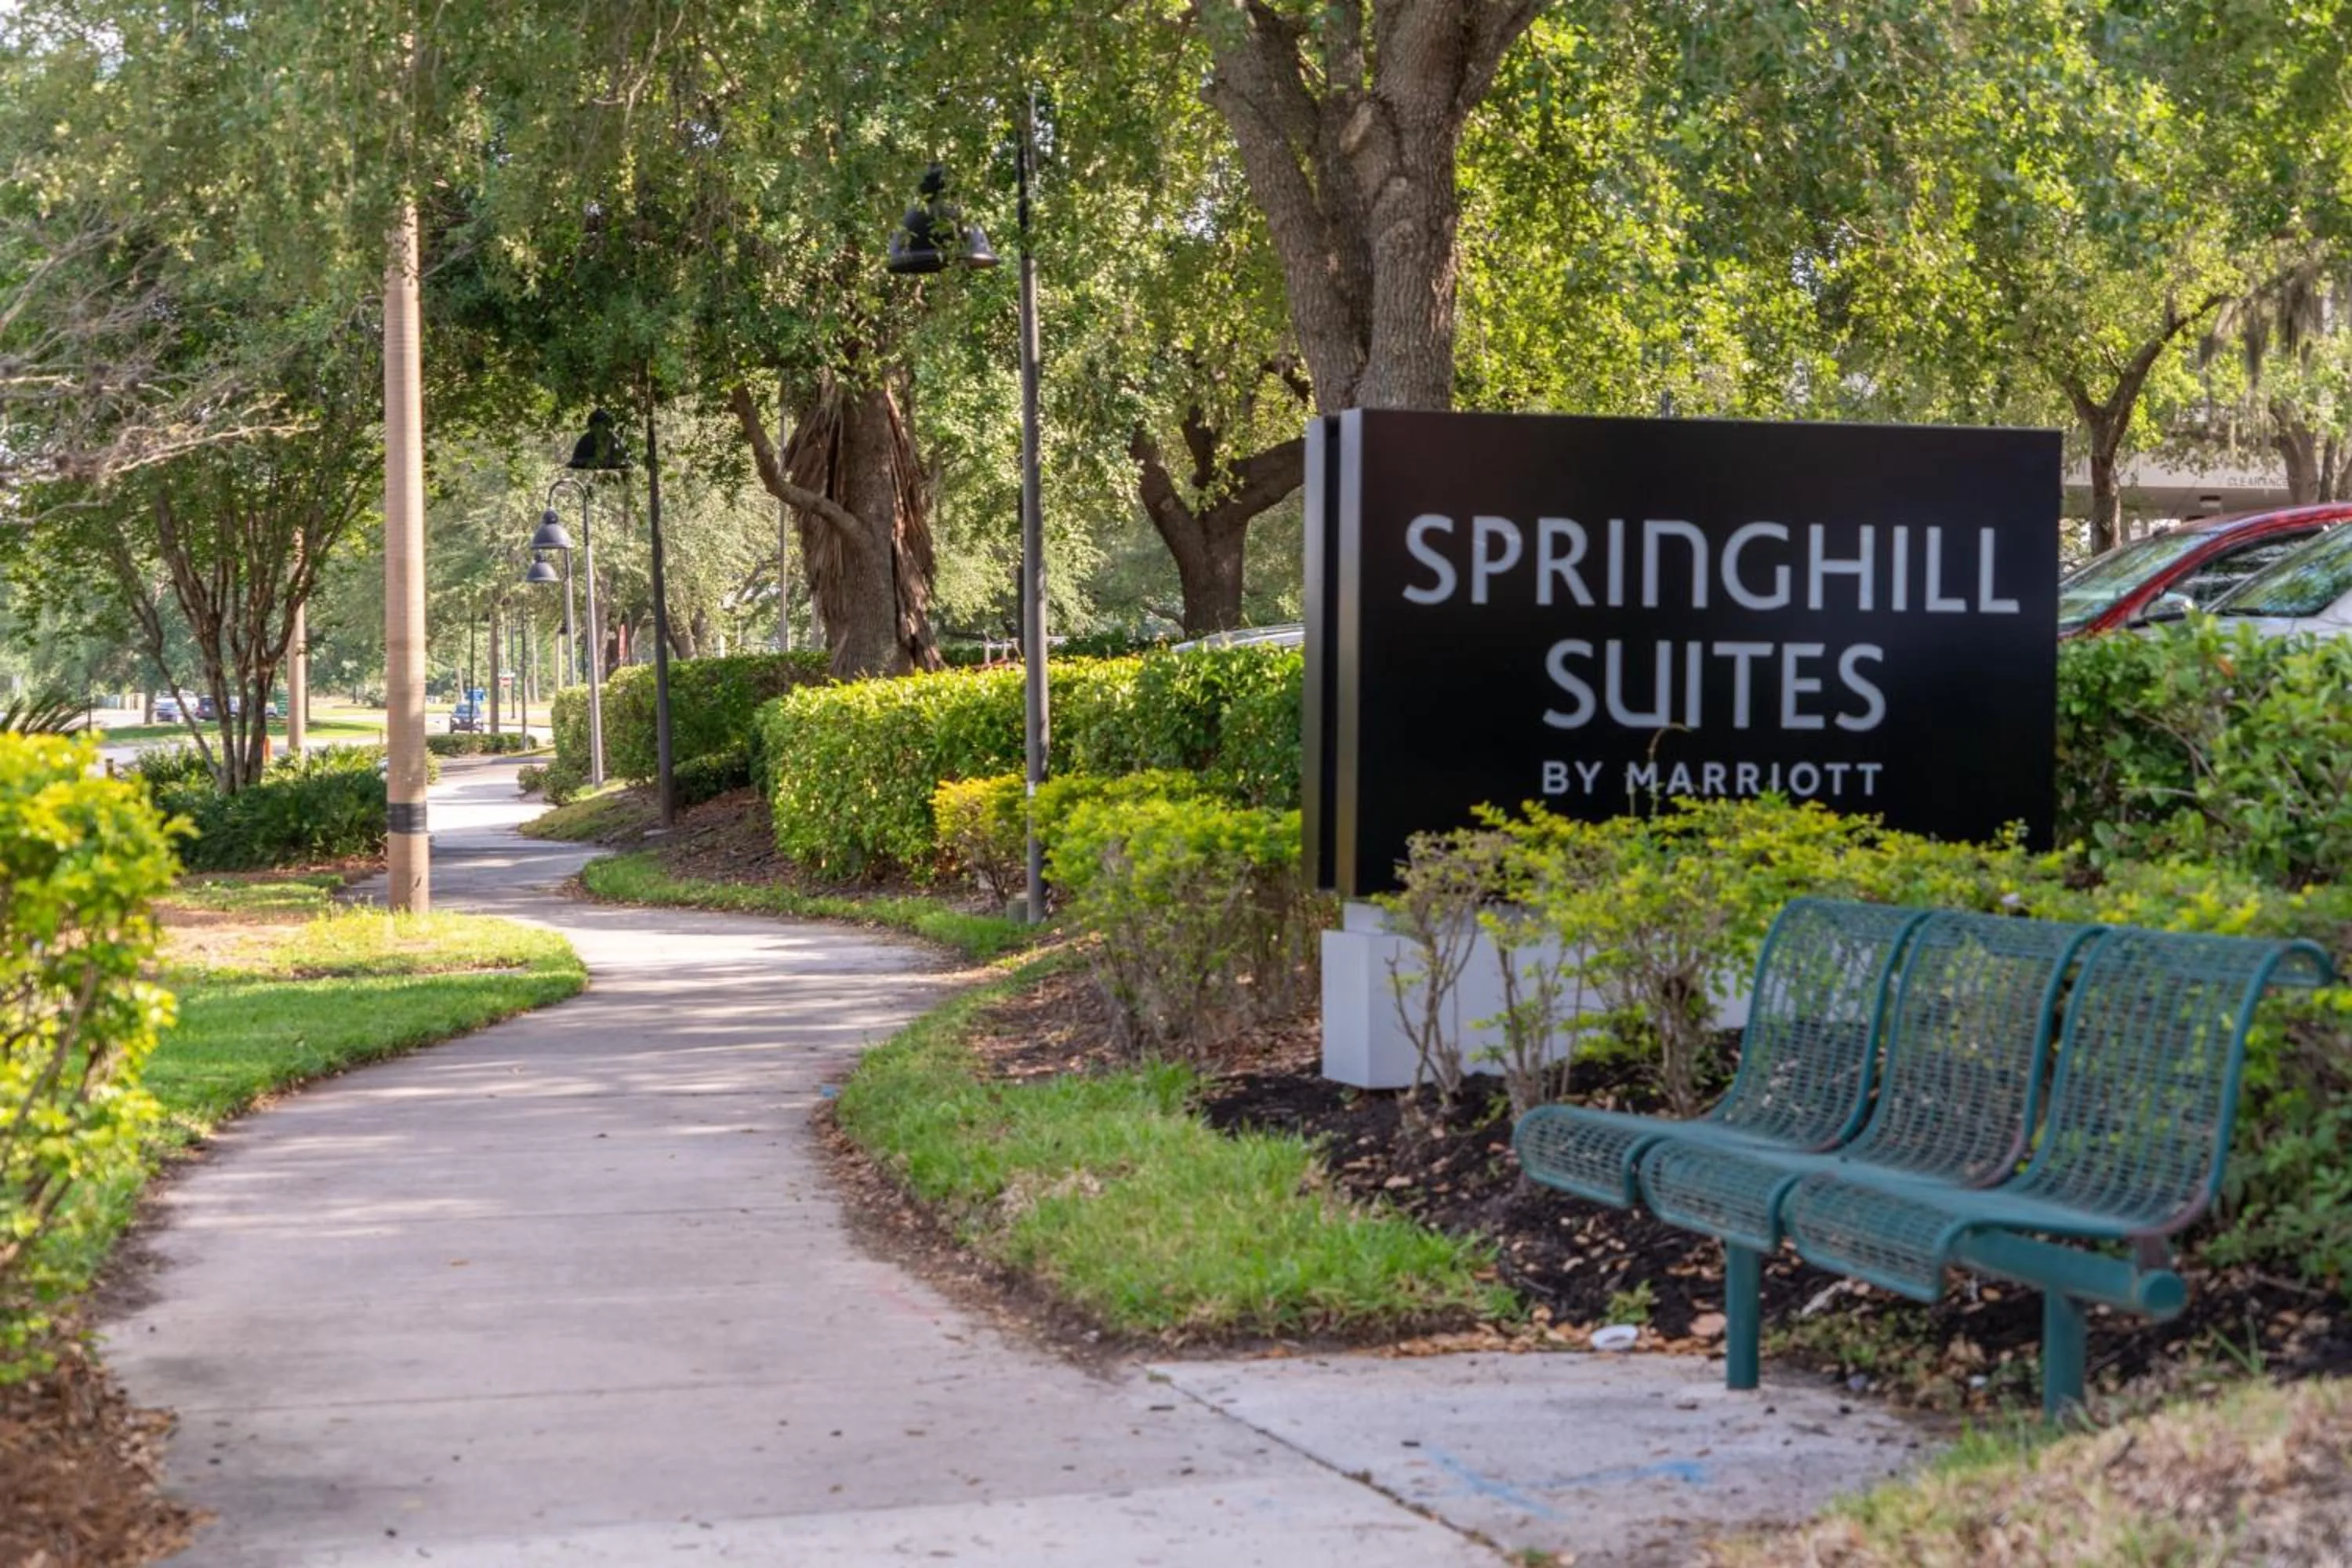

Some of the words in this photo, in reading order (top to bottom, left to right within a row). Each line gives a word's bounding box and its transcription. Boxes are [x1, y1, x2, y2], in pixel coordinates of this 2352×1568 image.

[1402, 513, 2020, 614] SPRINGHILL
[1542, 638, 1886, 731] SUITES
[1542, 760, 1602, 794] BY
[1626, 761, 1883, 796] MARRIOTT
